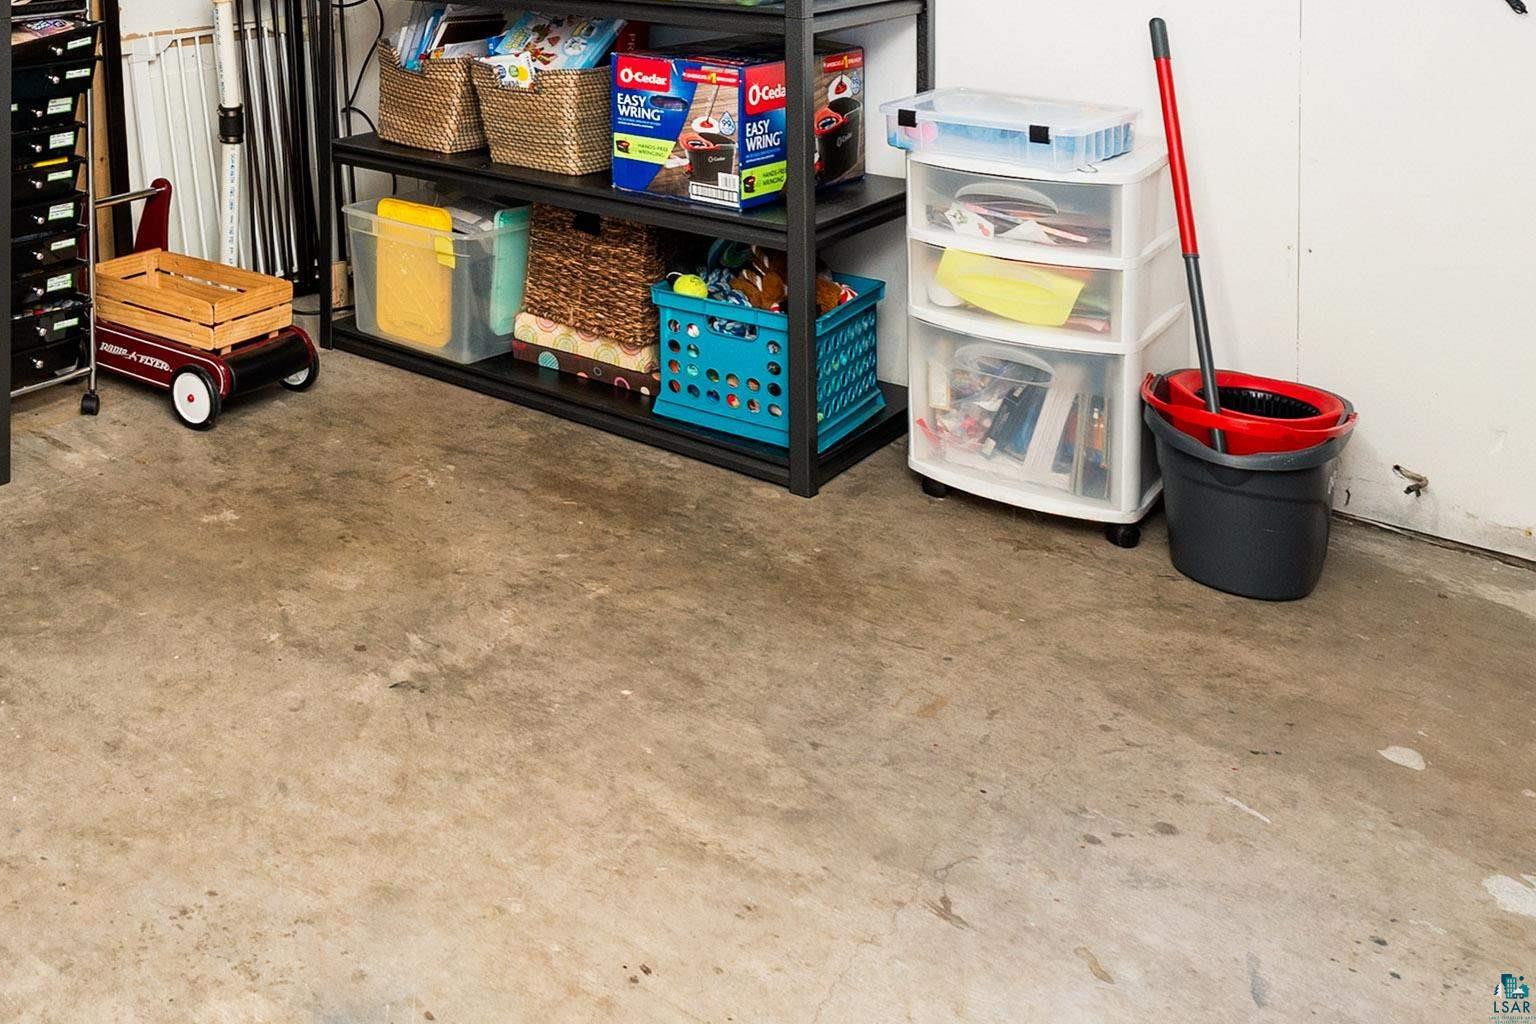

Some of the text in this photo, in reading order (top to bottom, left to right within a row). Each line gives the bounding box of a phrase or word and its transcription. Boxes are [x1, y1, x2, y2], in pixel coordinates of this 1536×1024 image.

[620, 68, 668, 86] O-Cedar
[617, 93, 646, 107] EASY
[749, 84, 786, 106] O-Ceda
[617, 104, 661, 121] WRING
[746, 119, 770, 137] EASY
[746, 132, 781, 152] WRING
